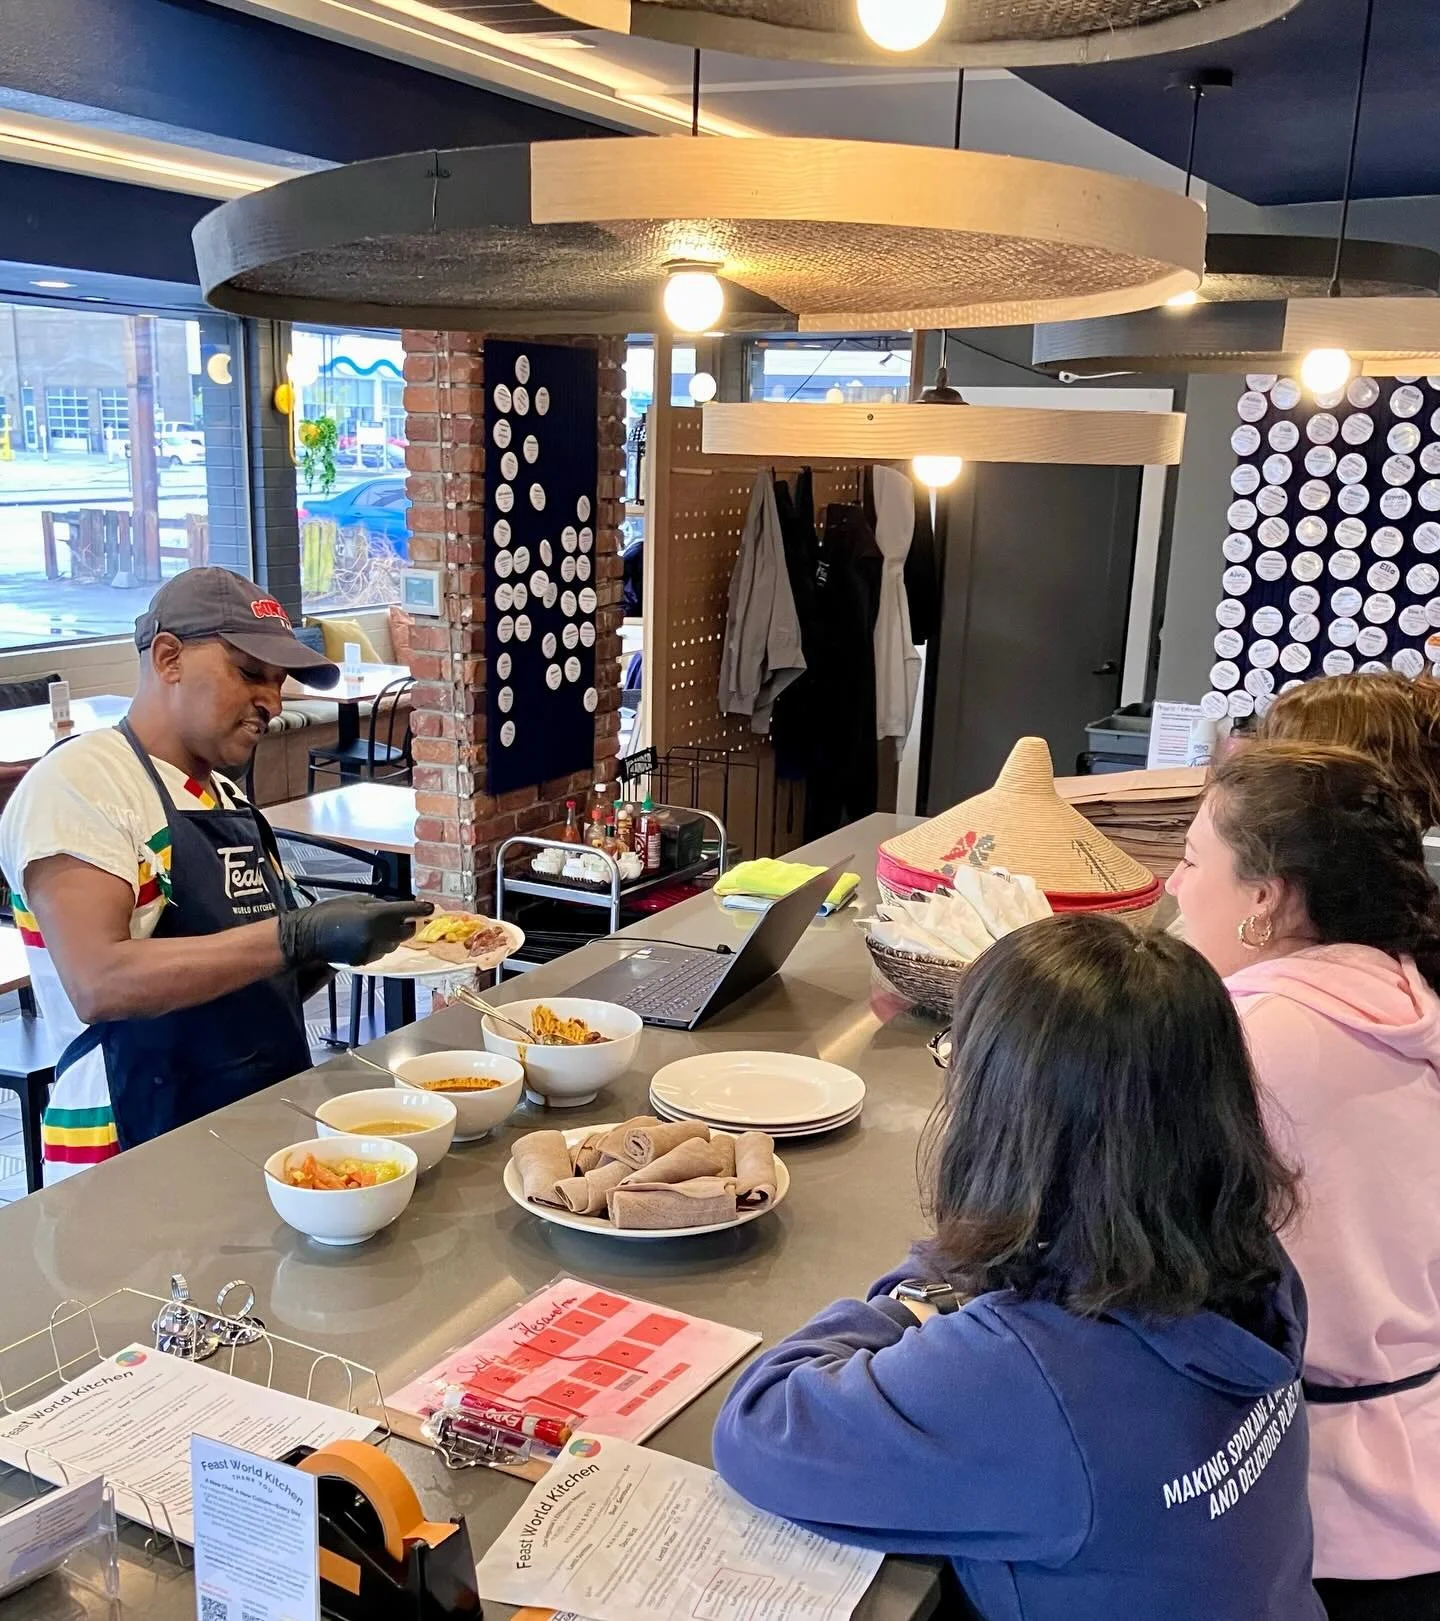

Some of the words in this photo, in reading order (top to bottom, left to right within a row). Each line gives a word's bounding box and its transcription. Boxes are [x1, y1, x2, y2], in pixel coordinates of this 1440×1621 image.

[232, 906, 252, 915] WORLD
[252, 902, 277, 913] KITCHEN
[1, 1420, 33, 1440] Feast
[27, 1395, 73, 1420] World
[72, 1371, 134, 1397] Kitchen
[1162, 1450, 1230, 1509] MAKING
[1227, 1397, 1270, 1466] SPOKANE
[1209, 1478, 1239, 1520] AND
[1237, 1419, 1282, 1495] DELICIOUS
[200, 1459, 229, 1472] Feast
[229, 1459, 263, 1477] World
[265, 1471, 304, 1506] Kitchen
[232, 1474, 255, 1483] THANK
[259, 1482, 273, 1493] YOU
[546, 1464, 600, 1503] Kitchen
[520, 1501, 554, 1538] World
[516, 1539, 534, 1569] Feast
